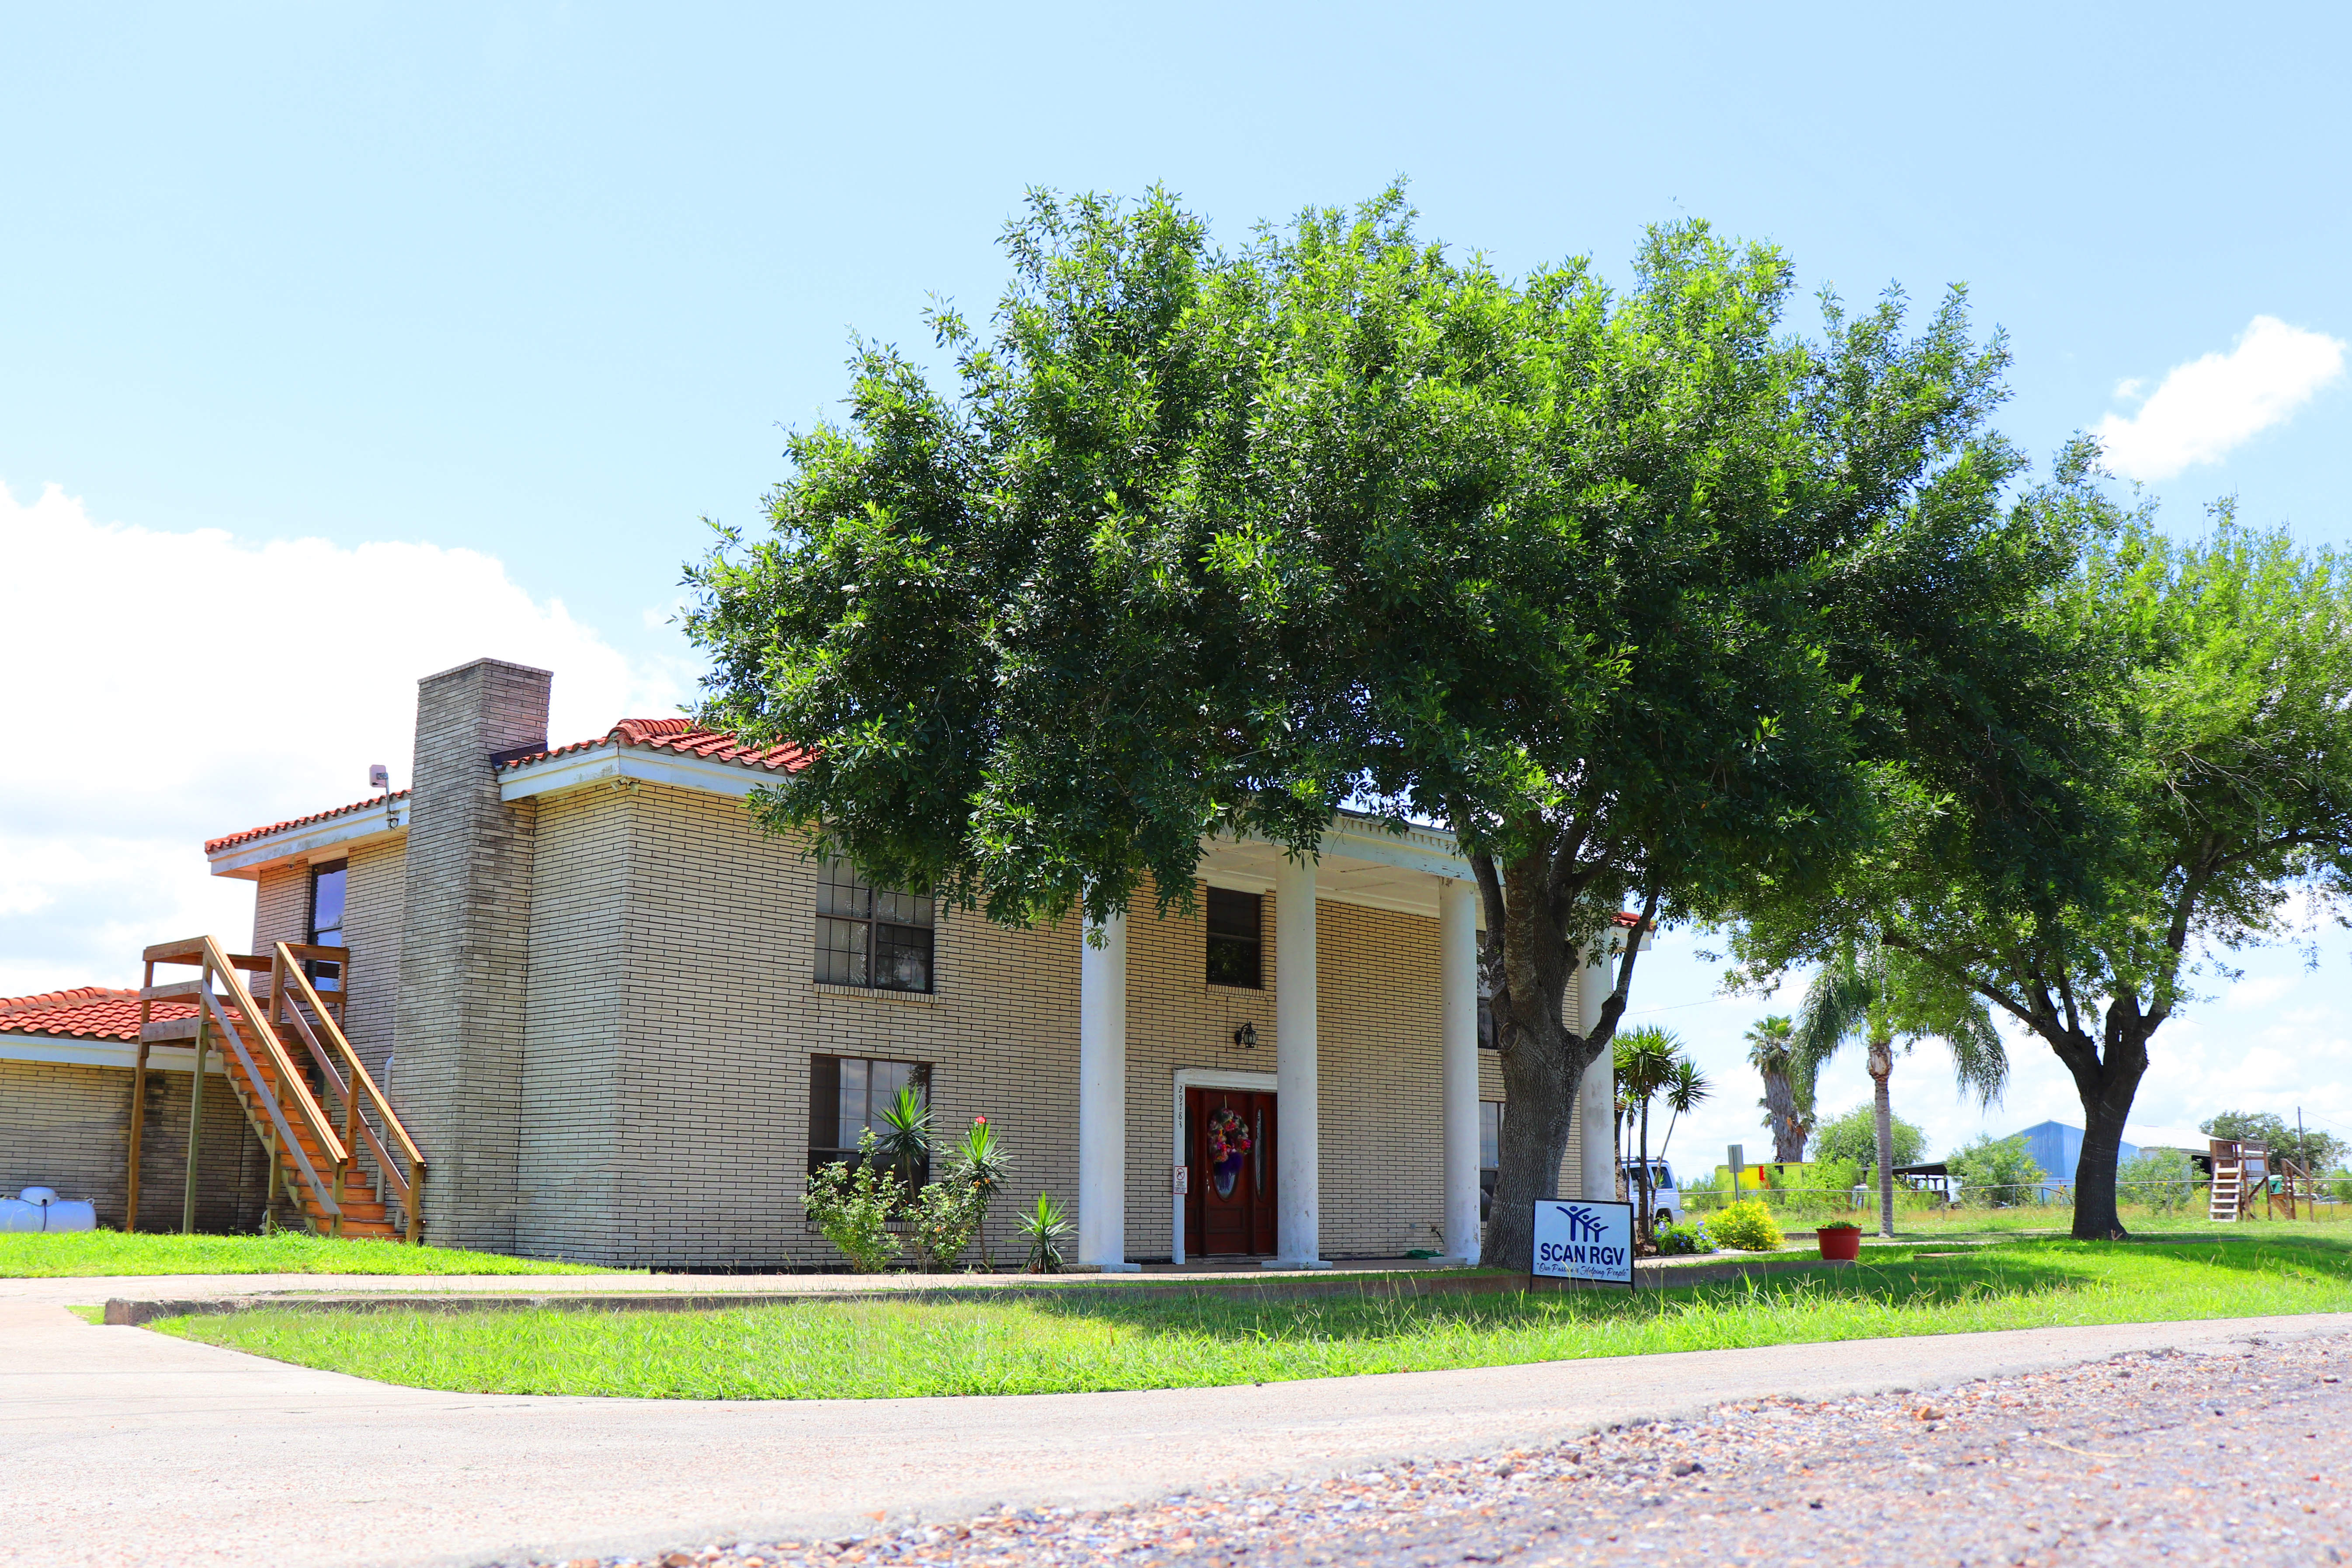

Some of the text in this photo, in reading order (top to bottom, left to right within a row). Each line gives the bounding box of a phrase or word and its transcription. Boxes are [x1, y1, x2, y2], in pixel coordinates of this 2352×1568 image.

[1541, 1242, 1625, 1266] SCAN RGV
[1580, 1266, 1604, 1278] Helping
